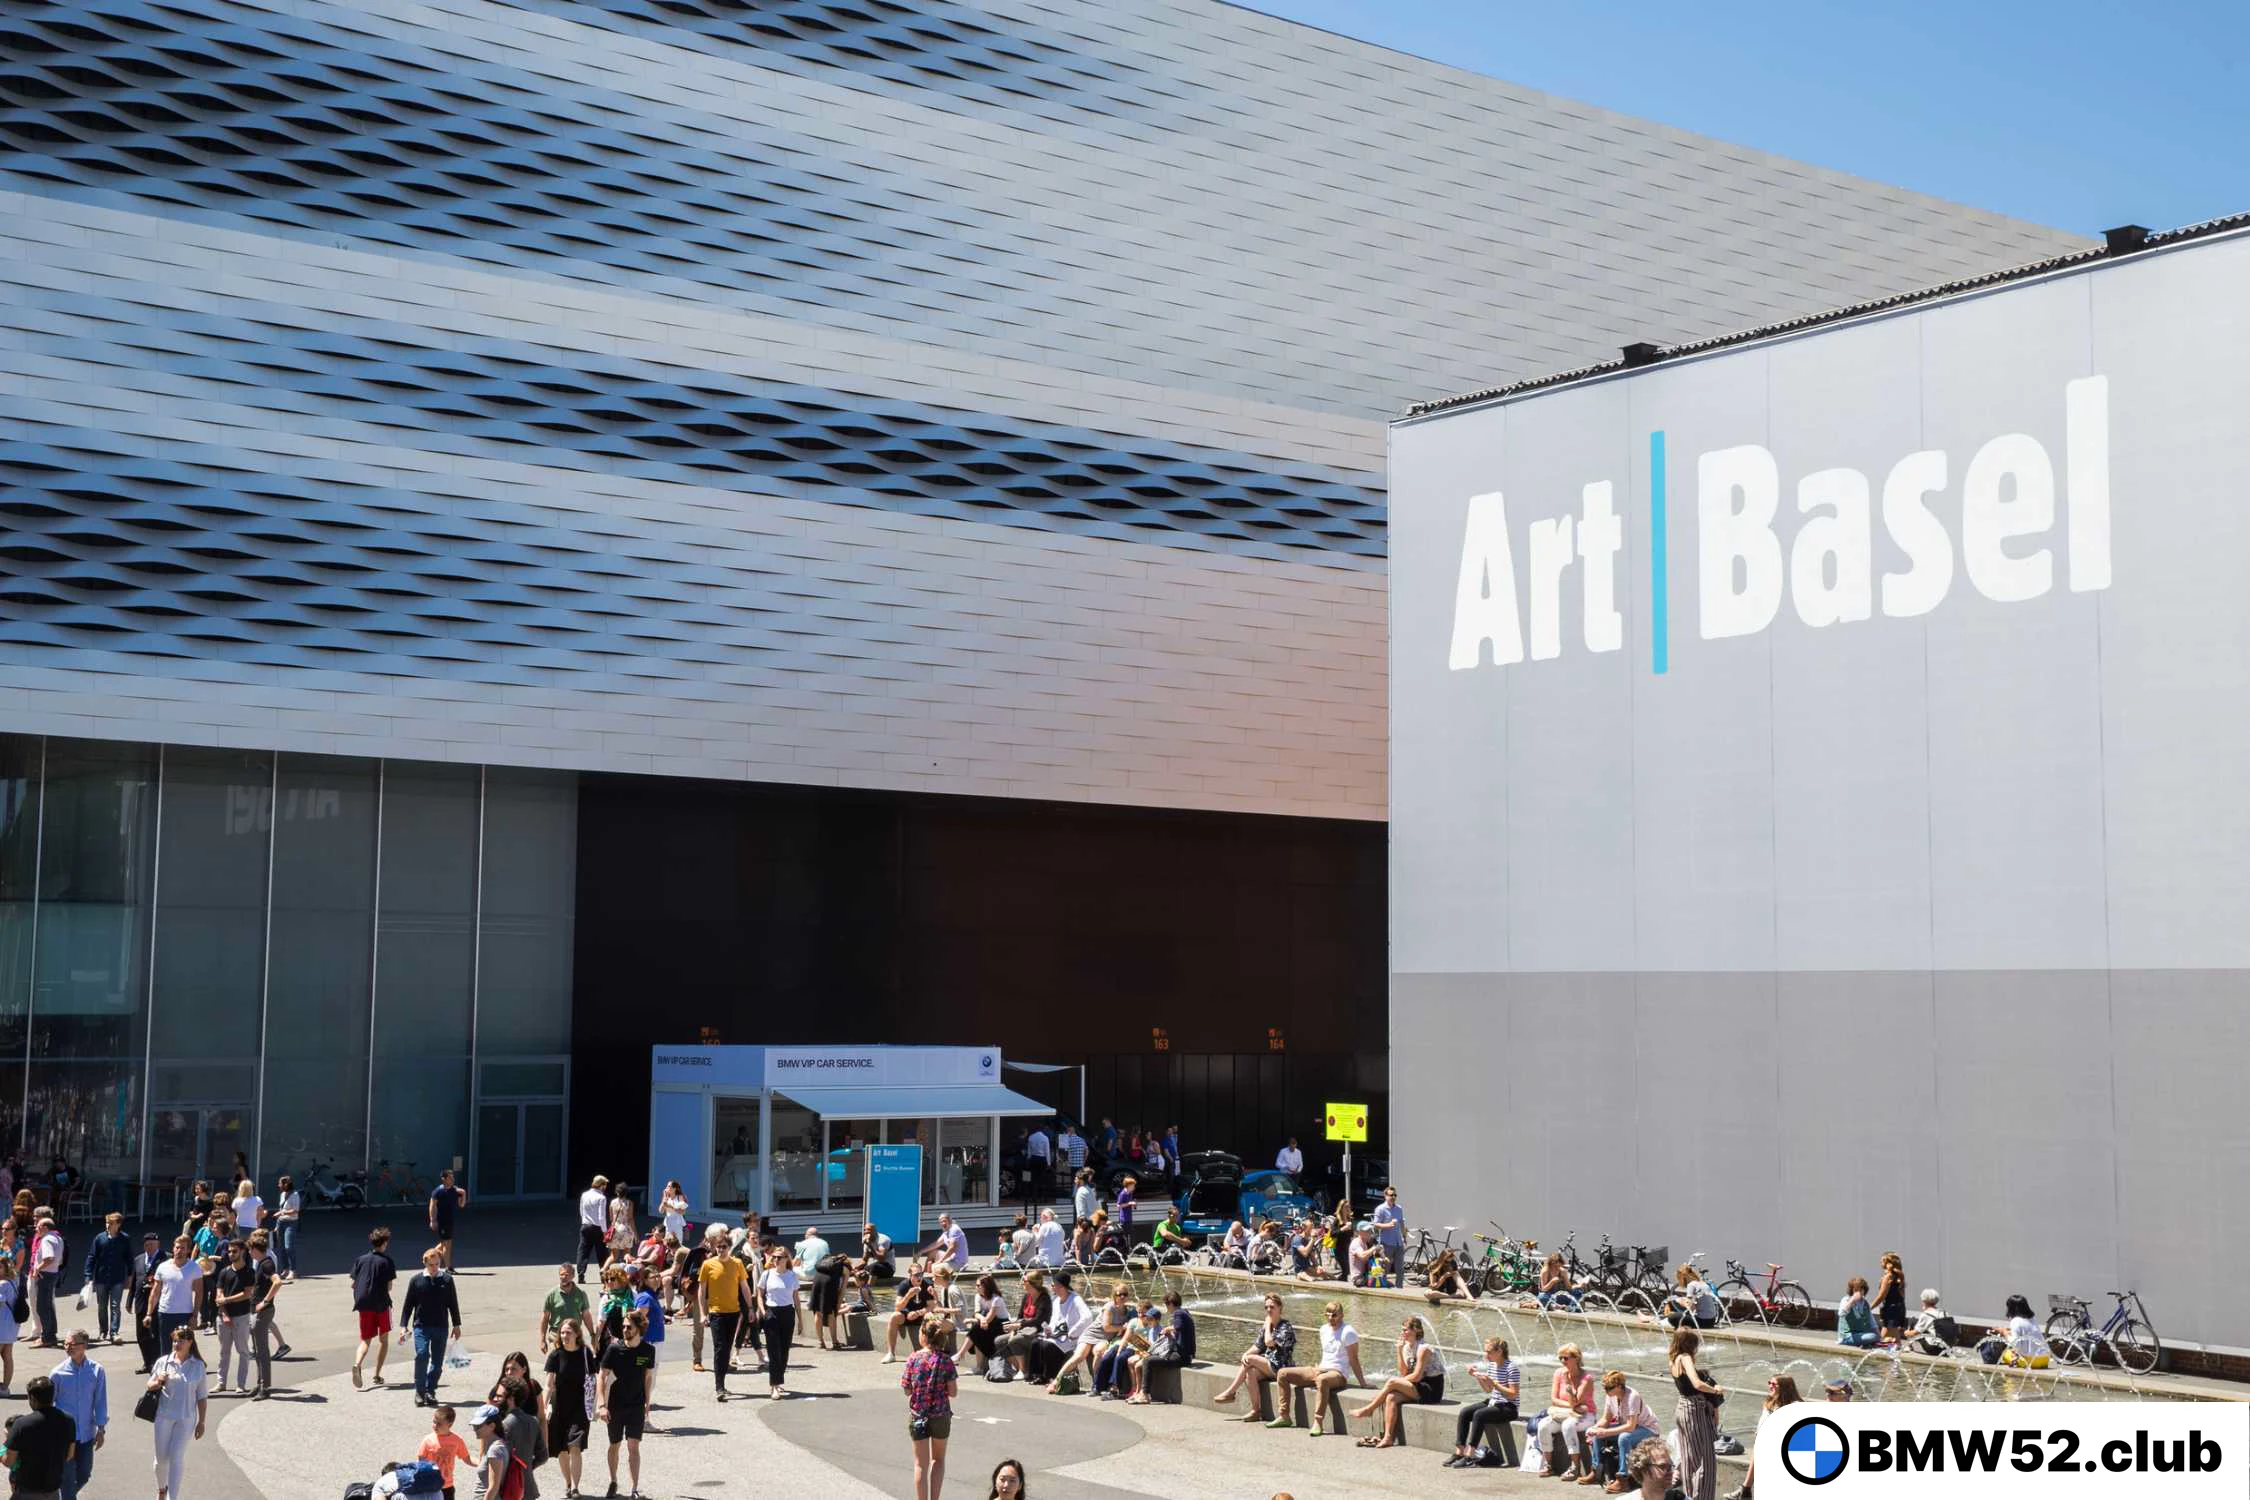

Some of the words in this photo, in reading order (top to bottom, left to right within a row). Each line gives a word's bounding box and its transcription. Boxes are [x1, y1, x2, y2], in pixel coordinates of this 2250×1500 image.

[1449, 480, 1622, 671] Art
[1698, 374, 2112, 640] Basel
[1154, 1038, 1169, 1049] 163
[777, 1059, 799, 1068] BMW
[801, 1059, 815, 1068] VIP
[816, 1059, 835, 1068] CAR
